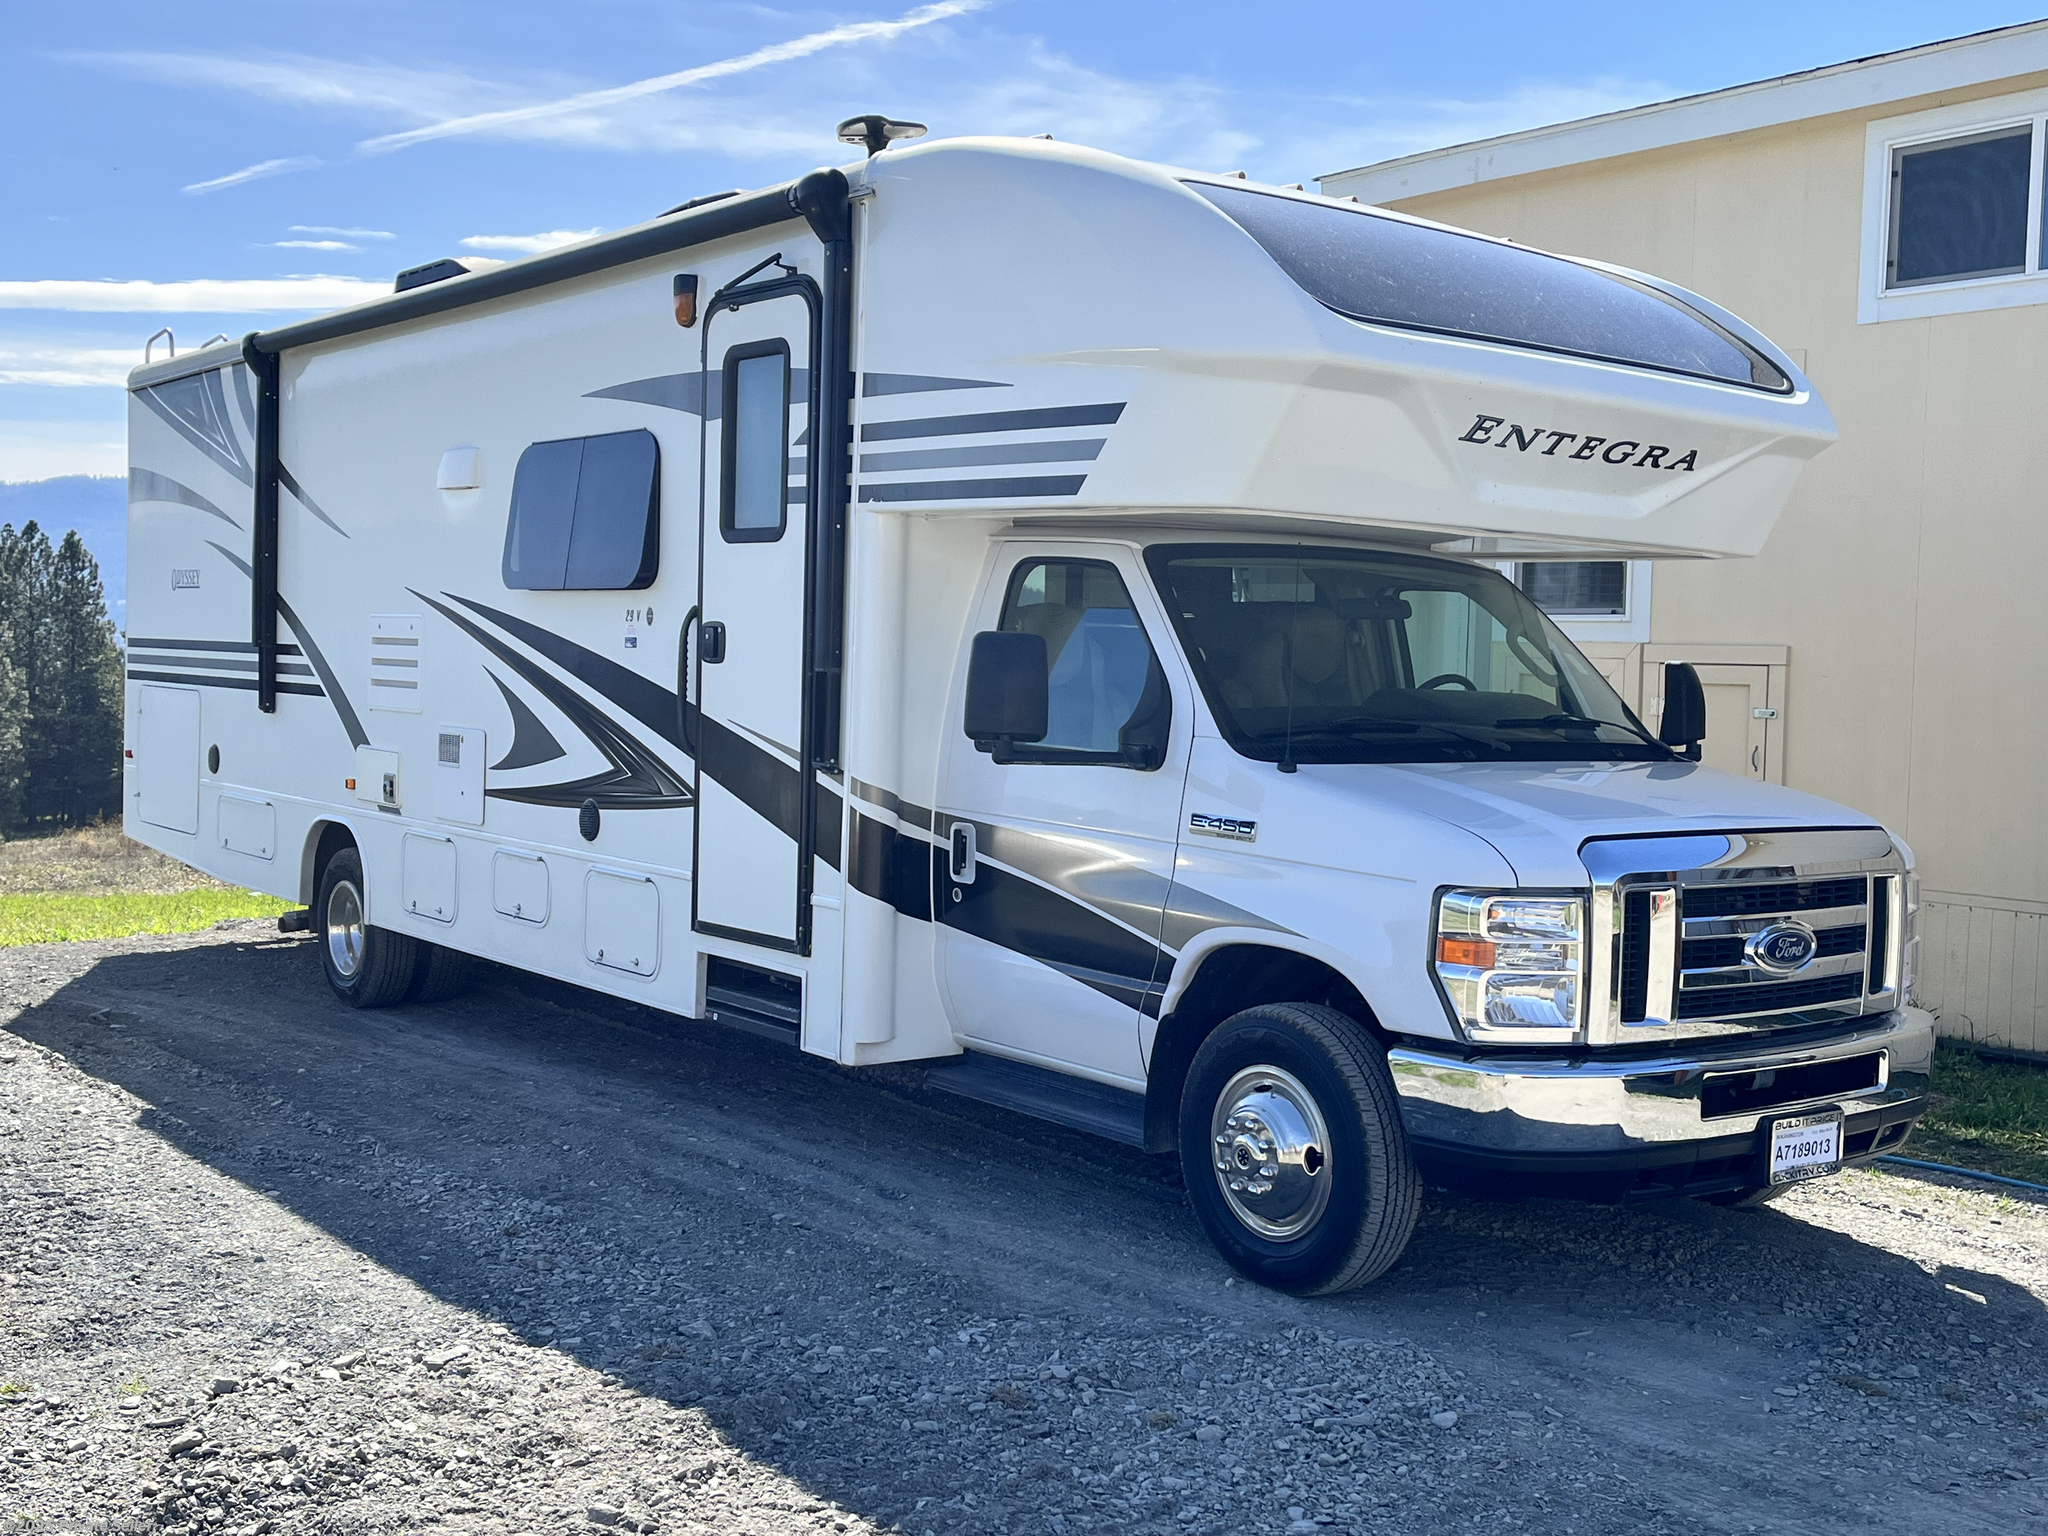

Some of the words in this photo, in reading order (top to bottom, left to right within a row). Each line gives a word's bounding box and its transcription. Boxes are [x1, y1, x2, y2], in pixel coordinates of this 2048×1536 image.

[1458, 414, 1699, 471] ENTEGRA
[172, 569, 201, 591] ODYSSEY
[625, 609, 634, 621] 29
[636, 609, 641, 621] V
[1190, 813, 1255, 834] E-450
[776, 937, 805, 959] Ford
[1775, 1119, 1801, 1131] BUILD
[1802, 1117, 1810, 1127] IT
[1810, 1114, 1835, 1124] PRICE
[1836, 1112, 1844, 1121] IT
[1775, 1138, 1832, 1162] A7189013
